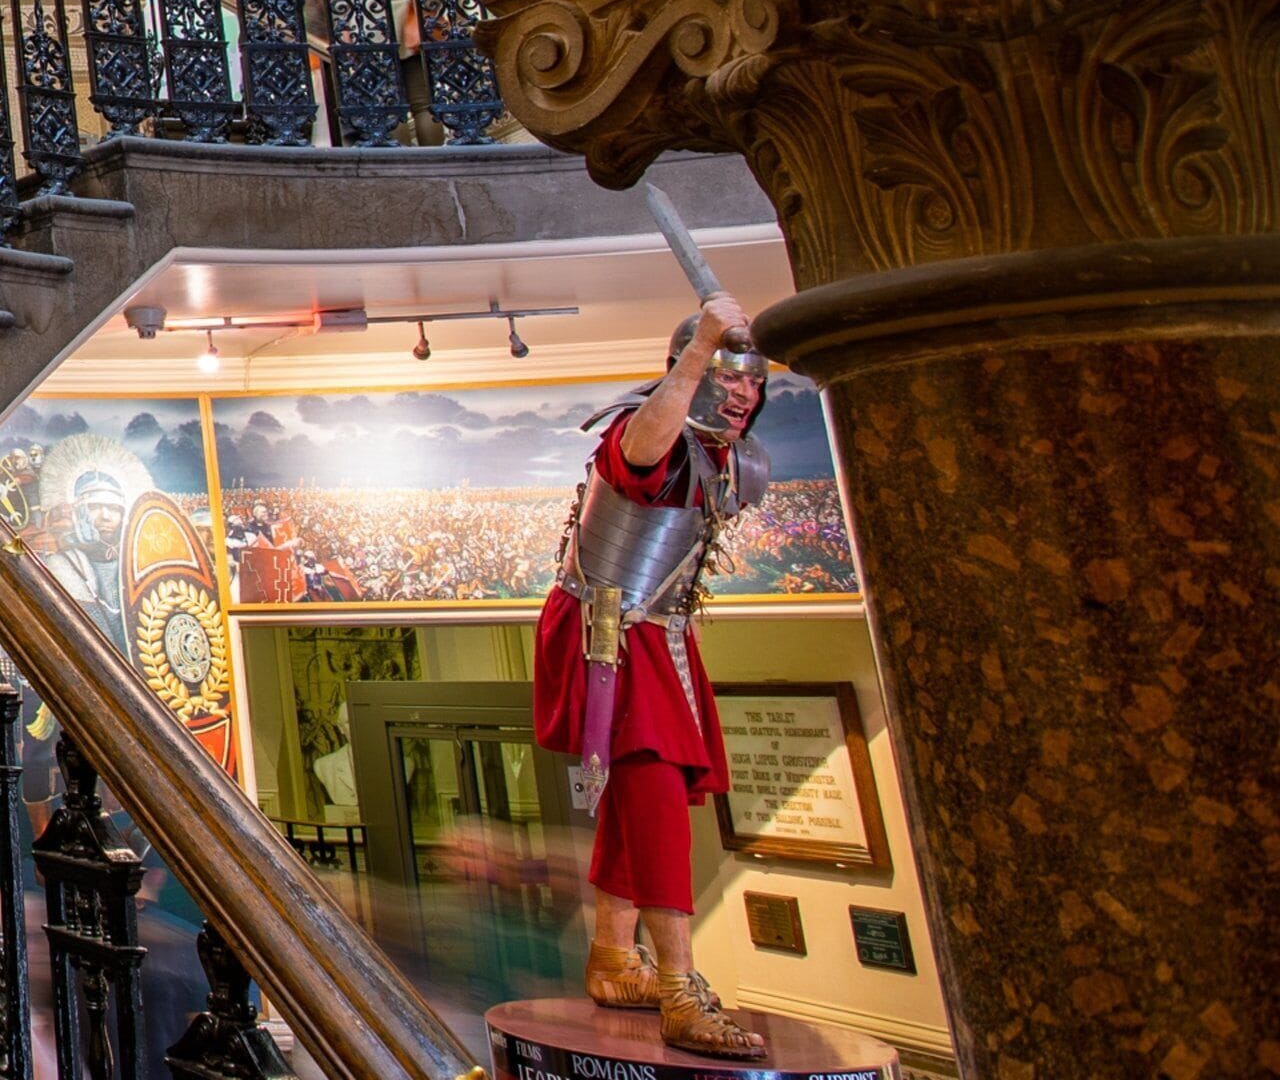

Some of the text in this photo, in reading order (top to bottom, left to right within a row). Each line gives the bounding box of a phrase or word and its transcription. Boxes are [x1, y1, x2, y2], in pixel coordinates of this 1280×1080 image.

[744, 711, 794, 724] THIS TABLET
[749, 727, 782, 736] GRATEFUL
[771, 741, 779, 750] OF
[764, 799, 778, 809] THE
[515, 1040, 542, 1061] FILMS
[571, 1054, 656, 1080] ROMANS
